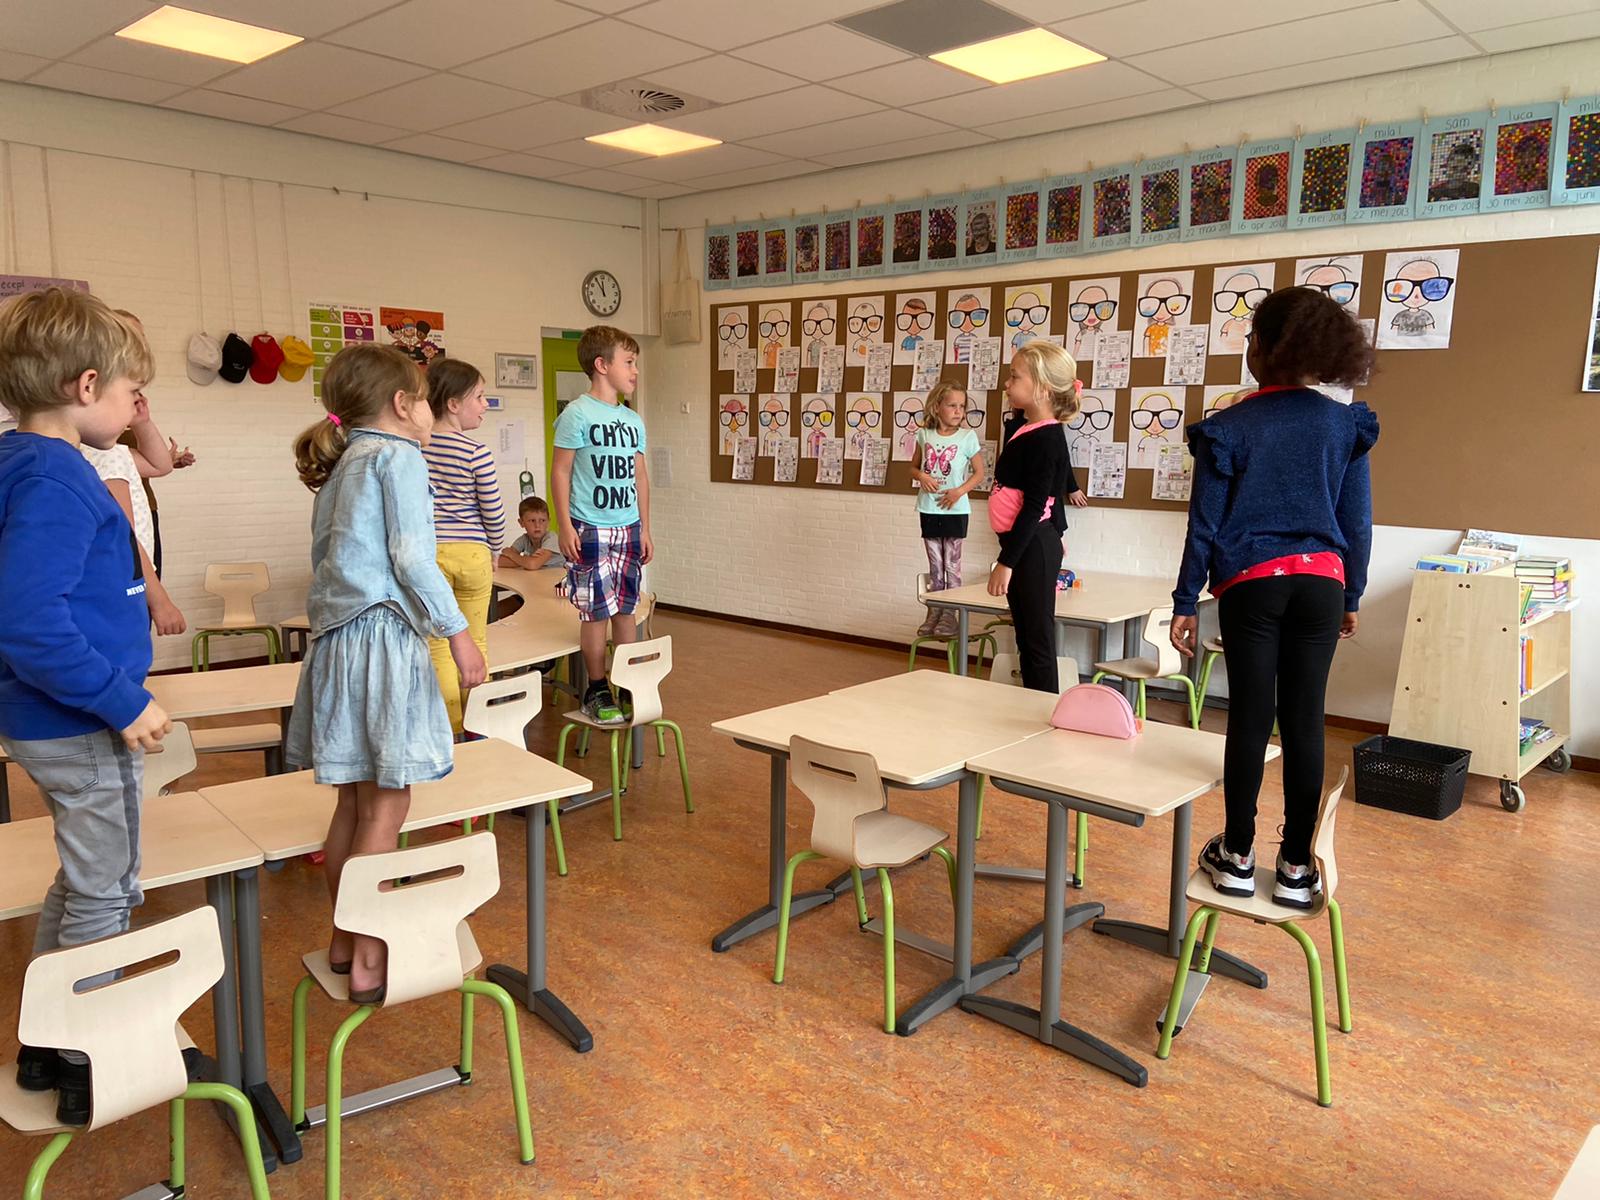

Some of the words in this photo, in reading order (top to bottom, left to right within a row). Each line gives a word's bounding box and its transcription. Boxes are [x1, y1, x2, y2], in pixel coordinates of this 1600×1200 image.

[1508, 110, 1533, 121] luca
[1446, 117, 1470, 130] sam
[1374, 126, 1395, 139] mila
[1318, 133, 1332, 146] jet
[1250, 143, 1279, 155] amina
[1503, 196, 1521, 207] mei
[1561, 191, 1569, 203] 9
[1573, 190, 1596, 203] juni
[1352, 210, 1365, 219] 22
[1370, 207, 1388, 219] mei
[1391, 207, 1409, 218] 2013
[1438, 202, 1457, 213] mei
[1308, 213, 1325, 223] mei
[1251, 221, 1265, 231] apr
